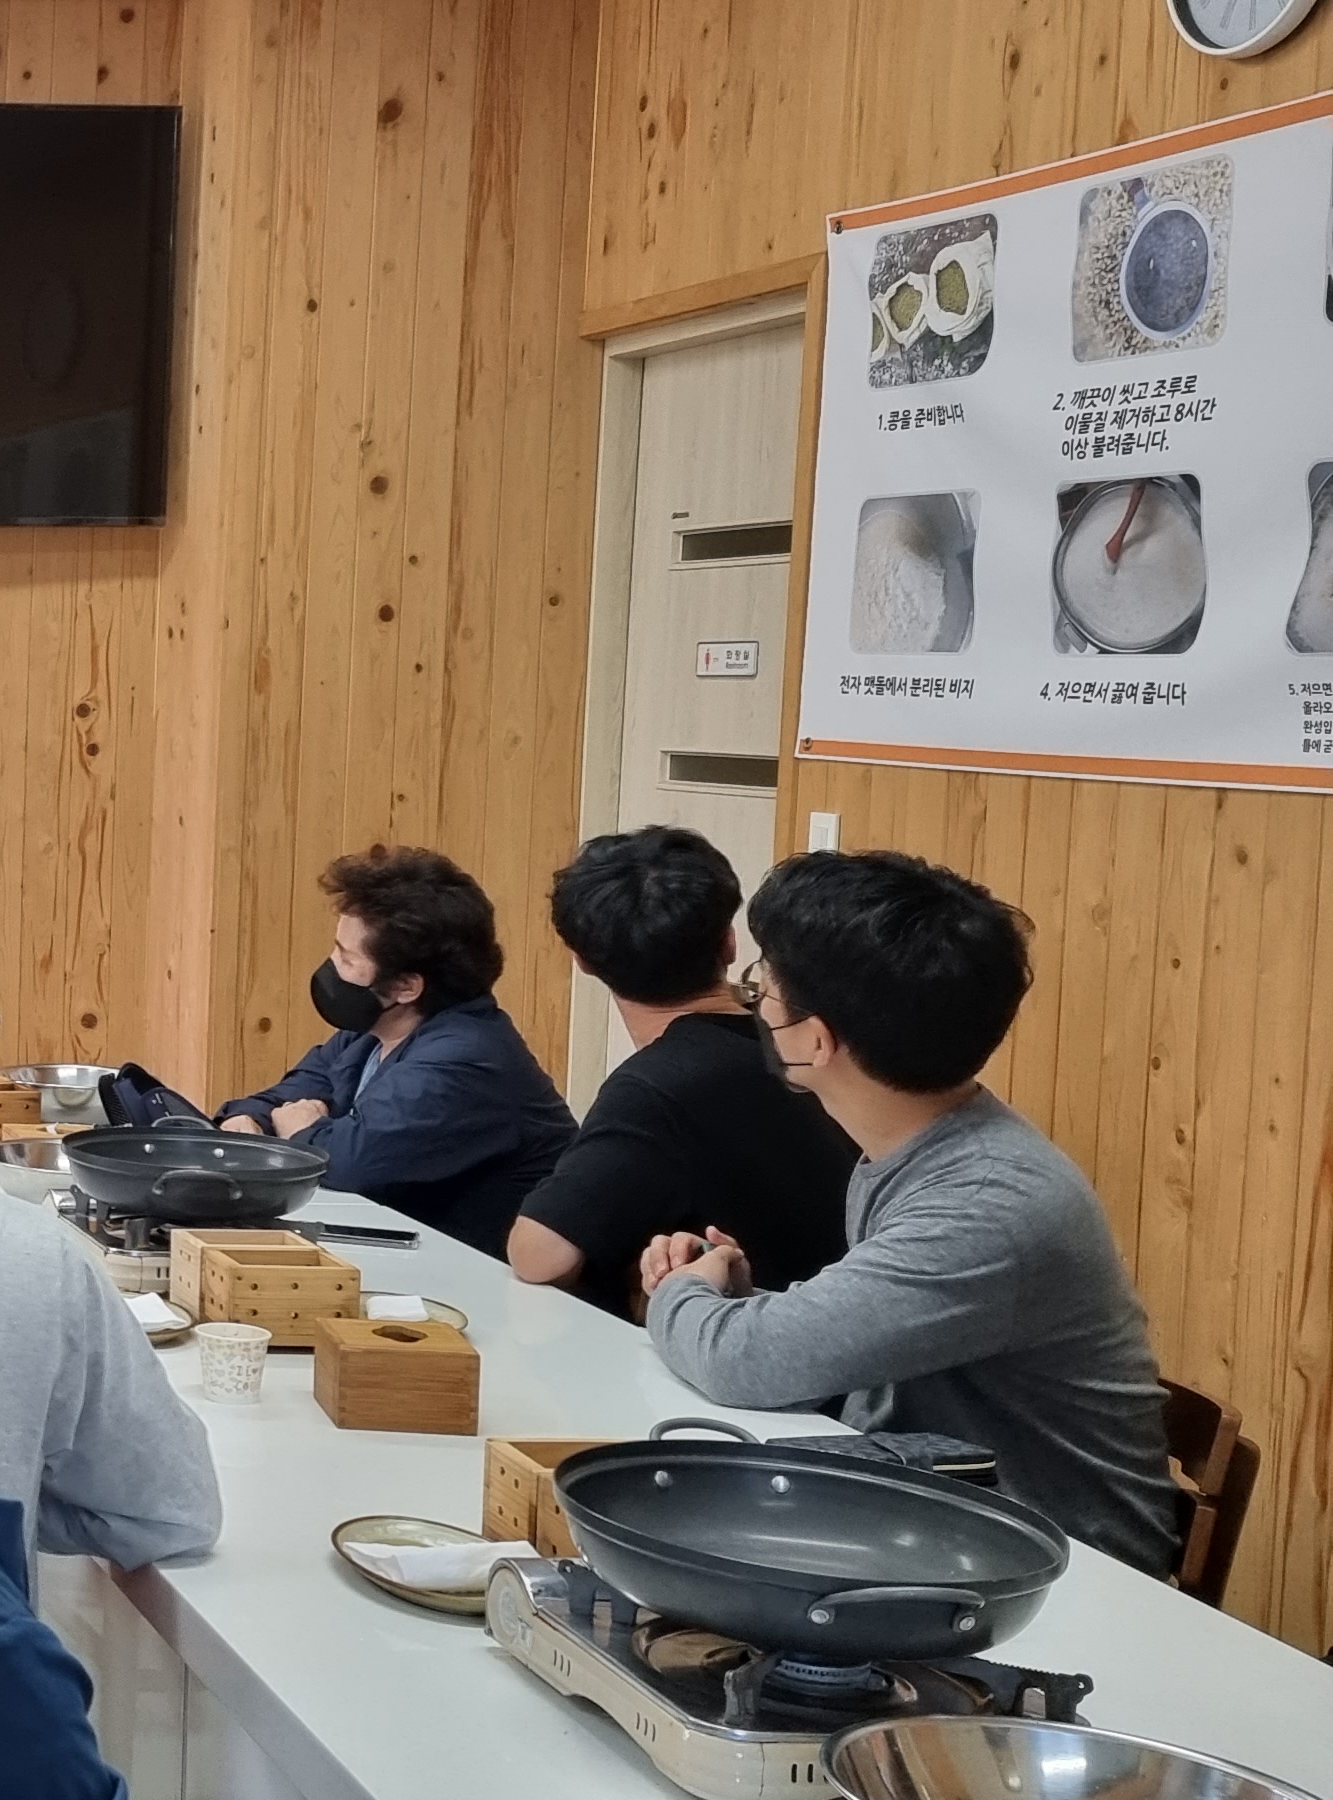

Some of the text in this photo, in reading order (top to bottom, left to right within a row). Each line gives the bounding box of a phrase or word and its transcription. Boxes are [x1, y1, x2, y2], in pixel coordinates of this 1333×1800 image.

[1052, 375, 1198, 411] 2. 깨끗이 씻고 조루로
[914, 403, 965, 428] 준비합니다
[1064, 397, 1217, 435] 이물질 제거하고 8시간
[1061, 429, 1170, 461] 이상 불려줍니다.
[839, 675, 975, 699] 전자 맷돌에서 분리된 비지
[1040, 681, 1187, 706] 4. 저으면서 끓여 줍니다
[1288, 684, 1299, 696] 5.
